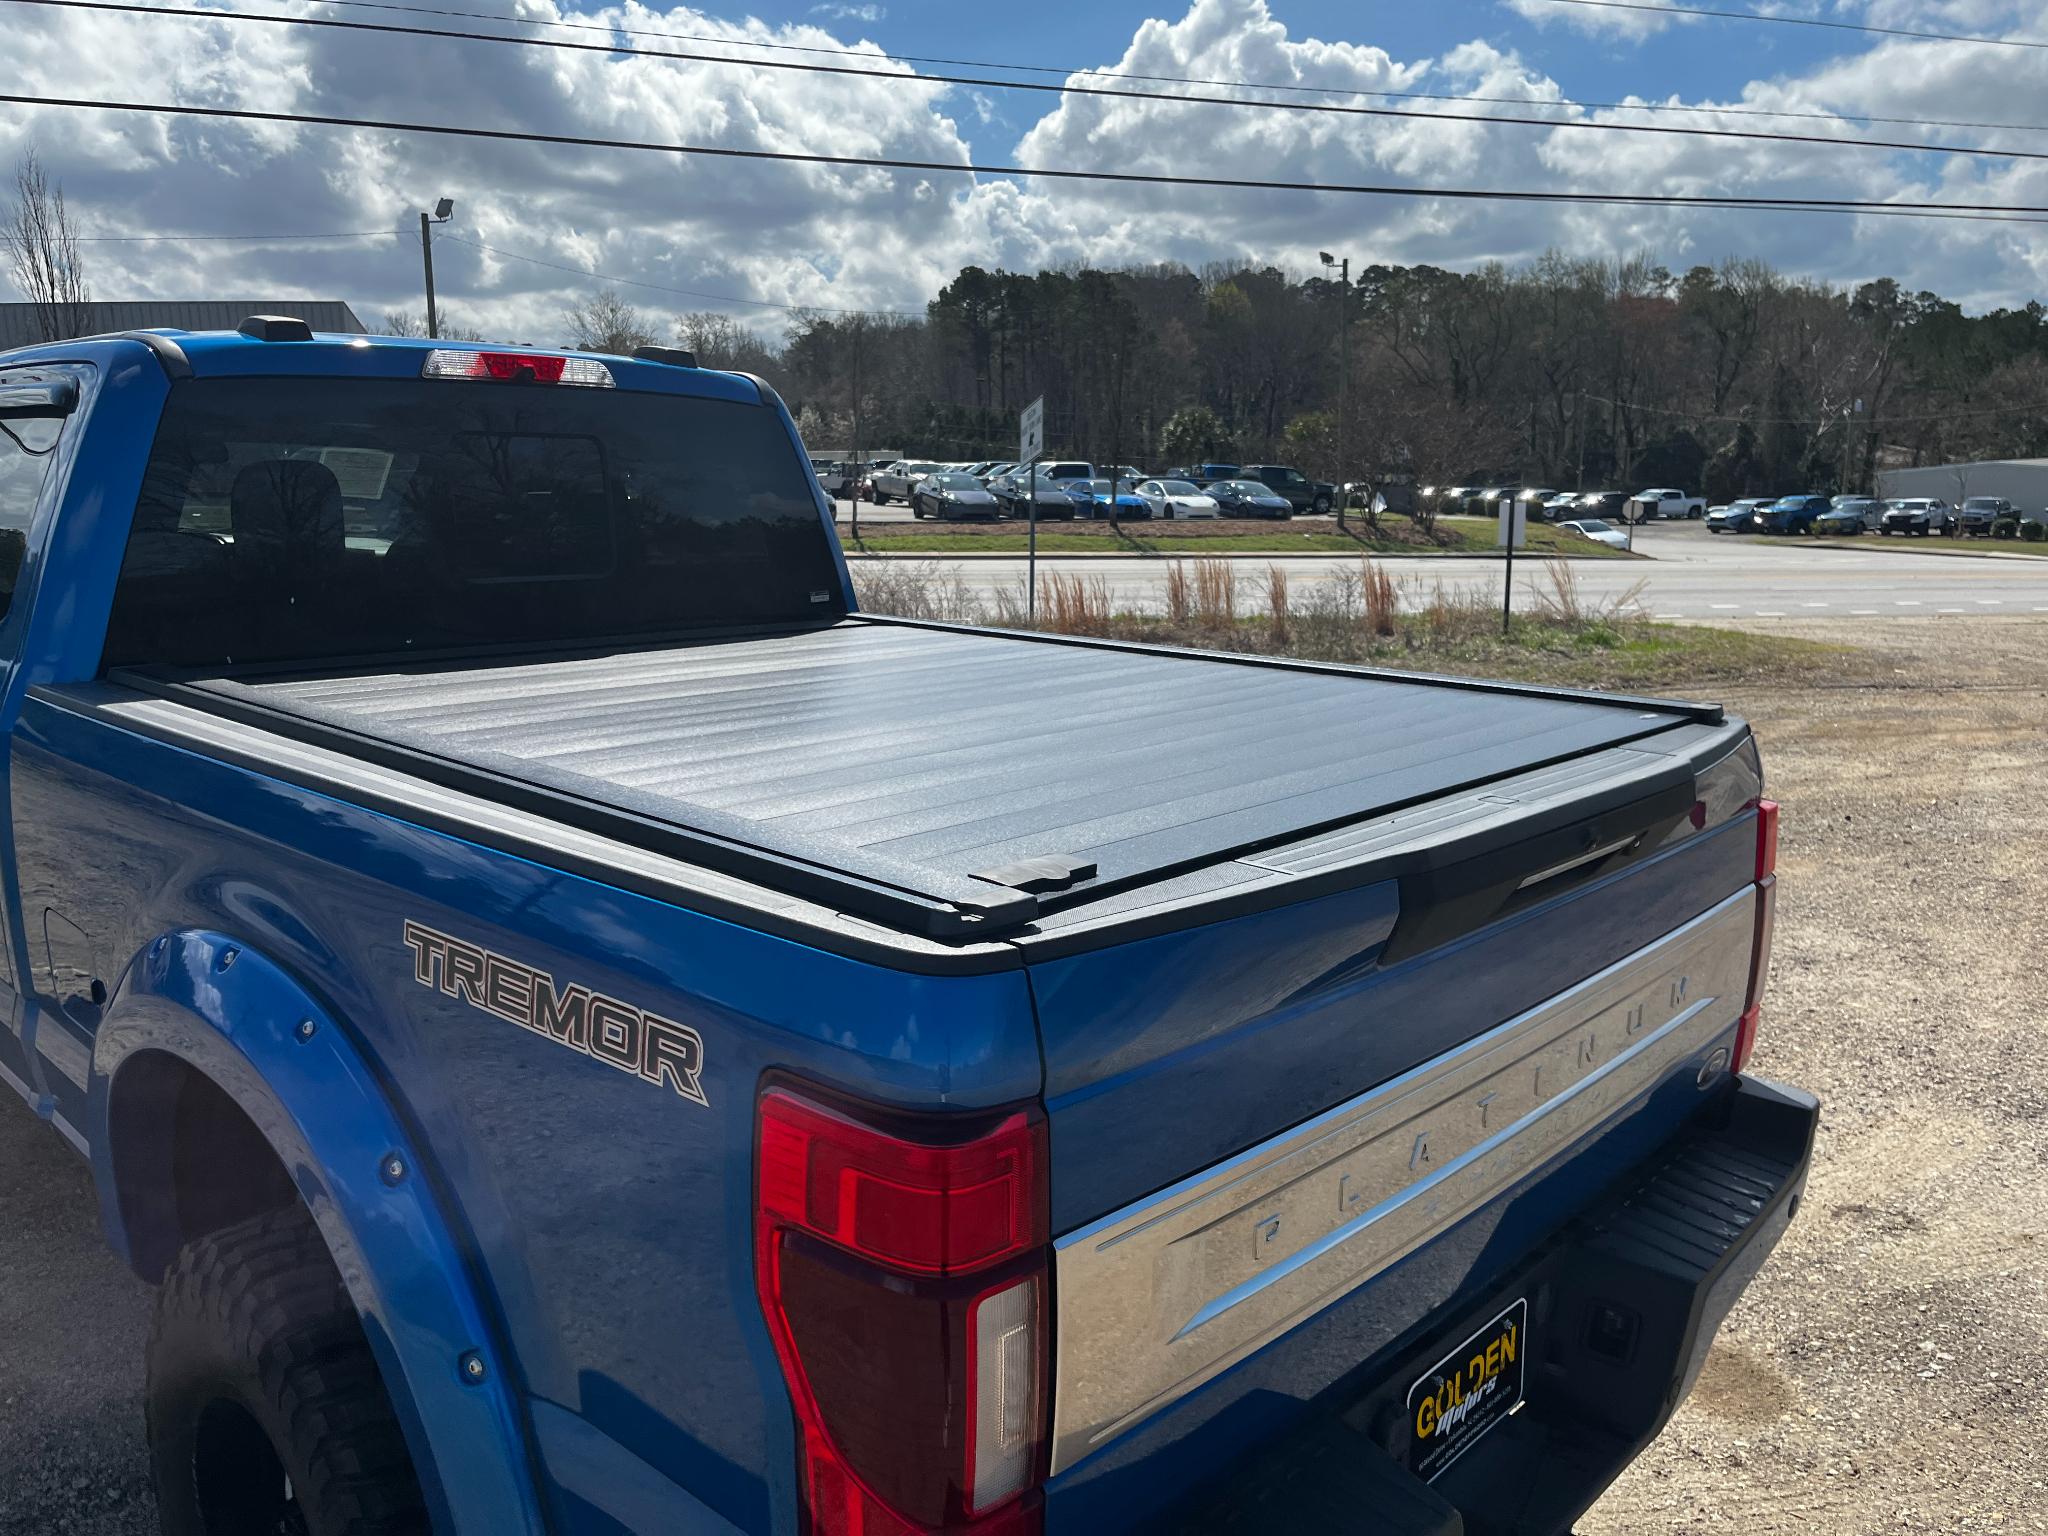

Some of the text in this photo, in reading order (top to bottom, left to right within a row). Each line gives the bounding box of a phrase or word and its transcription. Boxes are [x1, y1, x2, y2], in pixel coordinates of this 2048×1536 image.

[403, 919, 709, 1107] TREMOR
[1252, 976, 1689, 1261] PLATINUM
[1416, 1325, 1517, 1439] GOLDEN
